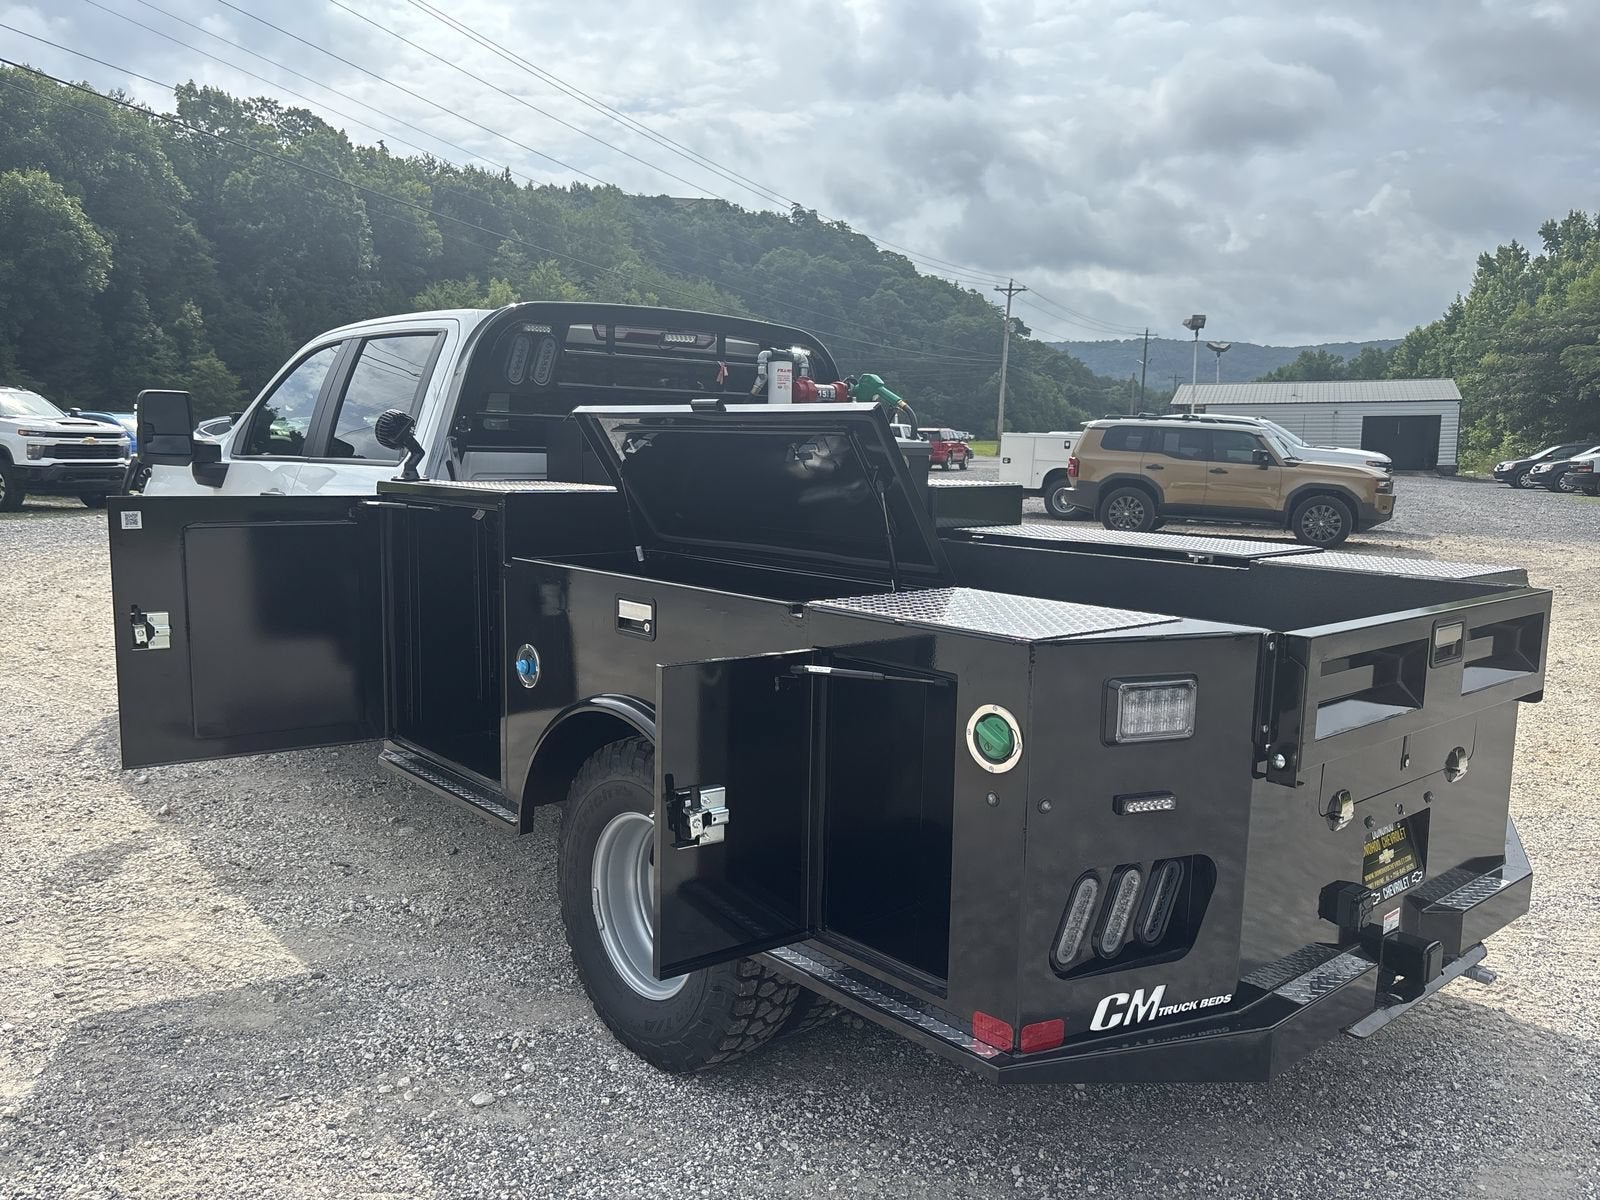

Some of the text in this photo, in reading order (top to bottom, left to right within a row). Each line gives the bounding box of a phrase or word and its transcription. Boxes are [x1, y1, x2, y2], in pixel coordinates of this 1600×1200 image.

[1382, 876, 1409, 900] CHEVROLET
[1090, 984, 1232, 1031] CM TRUCK BEDS
